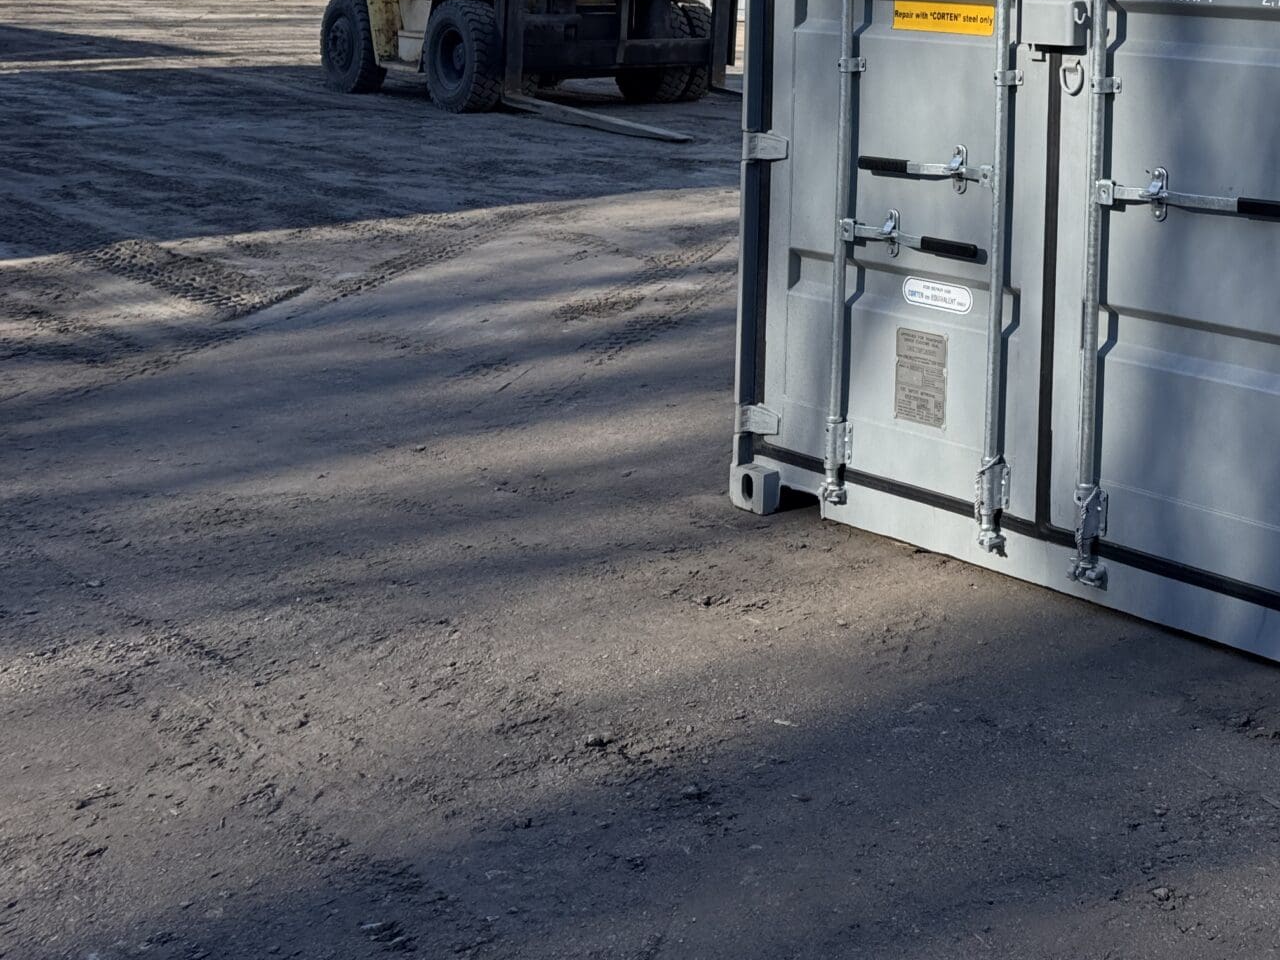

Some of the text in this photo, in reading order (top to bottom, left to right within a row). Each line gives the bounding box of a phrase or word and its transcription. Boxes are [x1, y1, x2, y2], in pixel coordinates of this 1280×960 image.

[894, 9, 993, 26] Repair with "CORTEN" steel only
